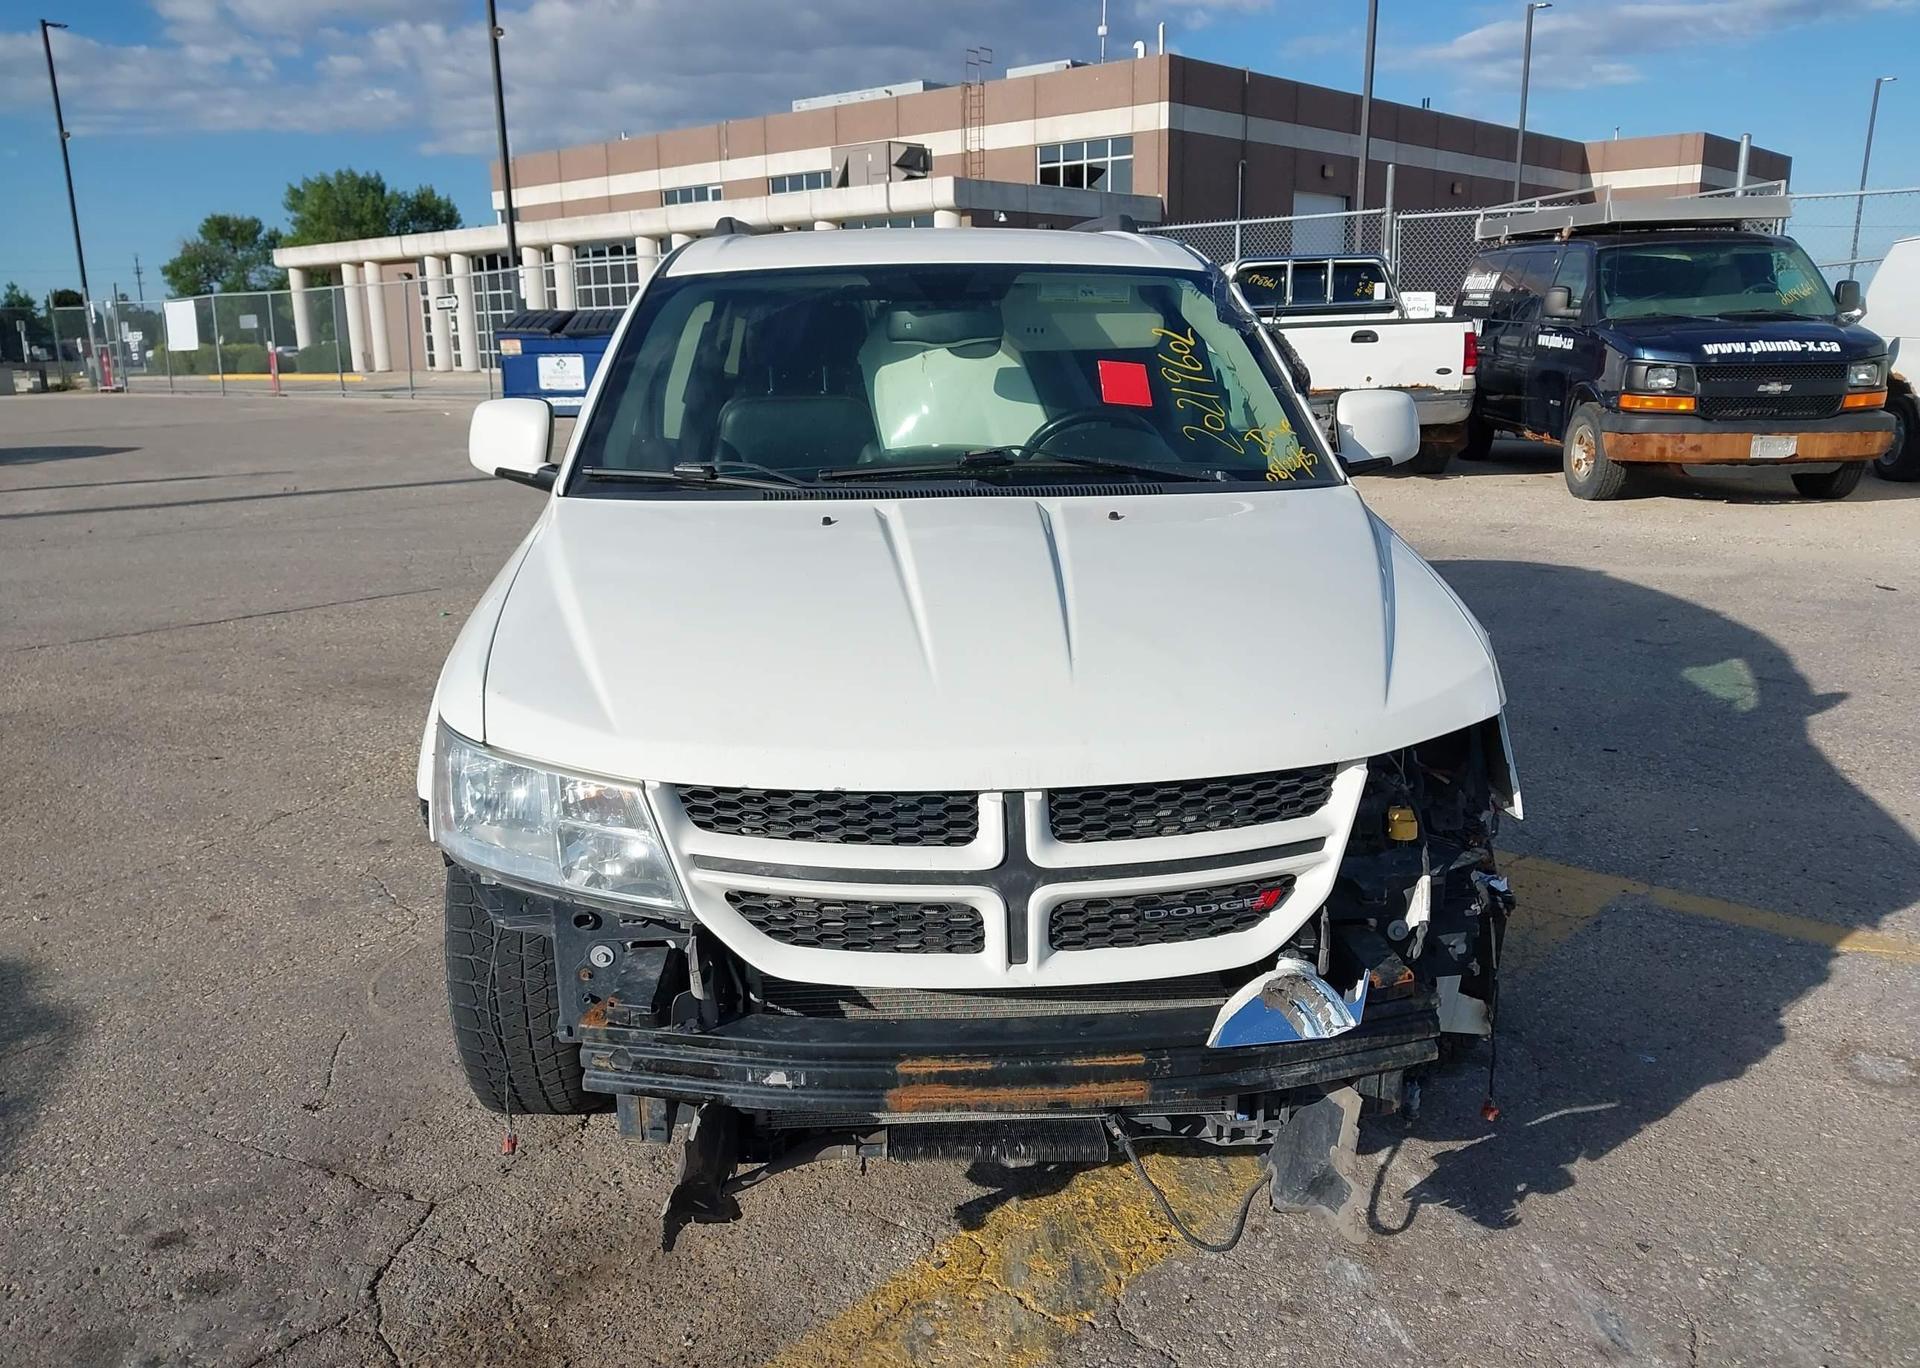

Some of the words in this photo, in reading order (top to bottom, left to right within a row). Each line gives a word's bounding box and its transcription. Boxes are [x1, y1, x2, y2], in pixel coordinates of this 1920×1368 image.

[1537, 333, 1574, 350] www.plumb-x.ca
[1702, 340, 1841, 355] www.plumb-x.ca
[1144, 896, 1264, 920] DODGE
